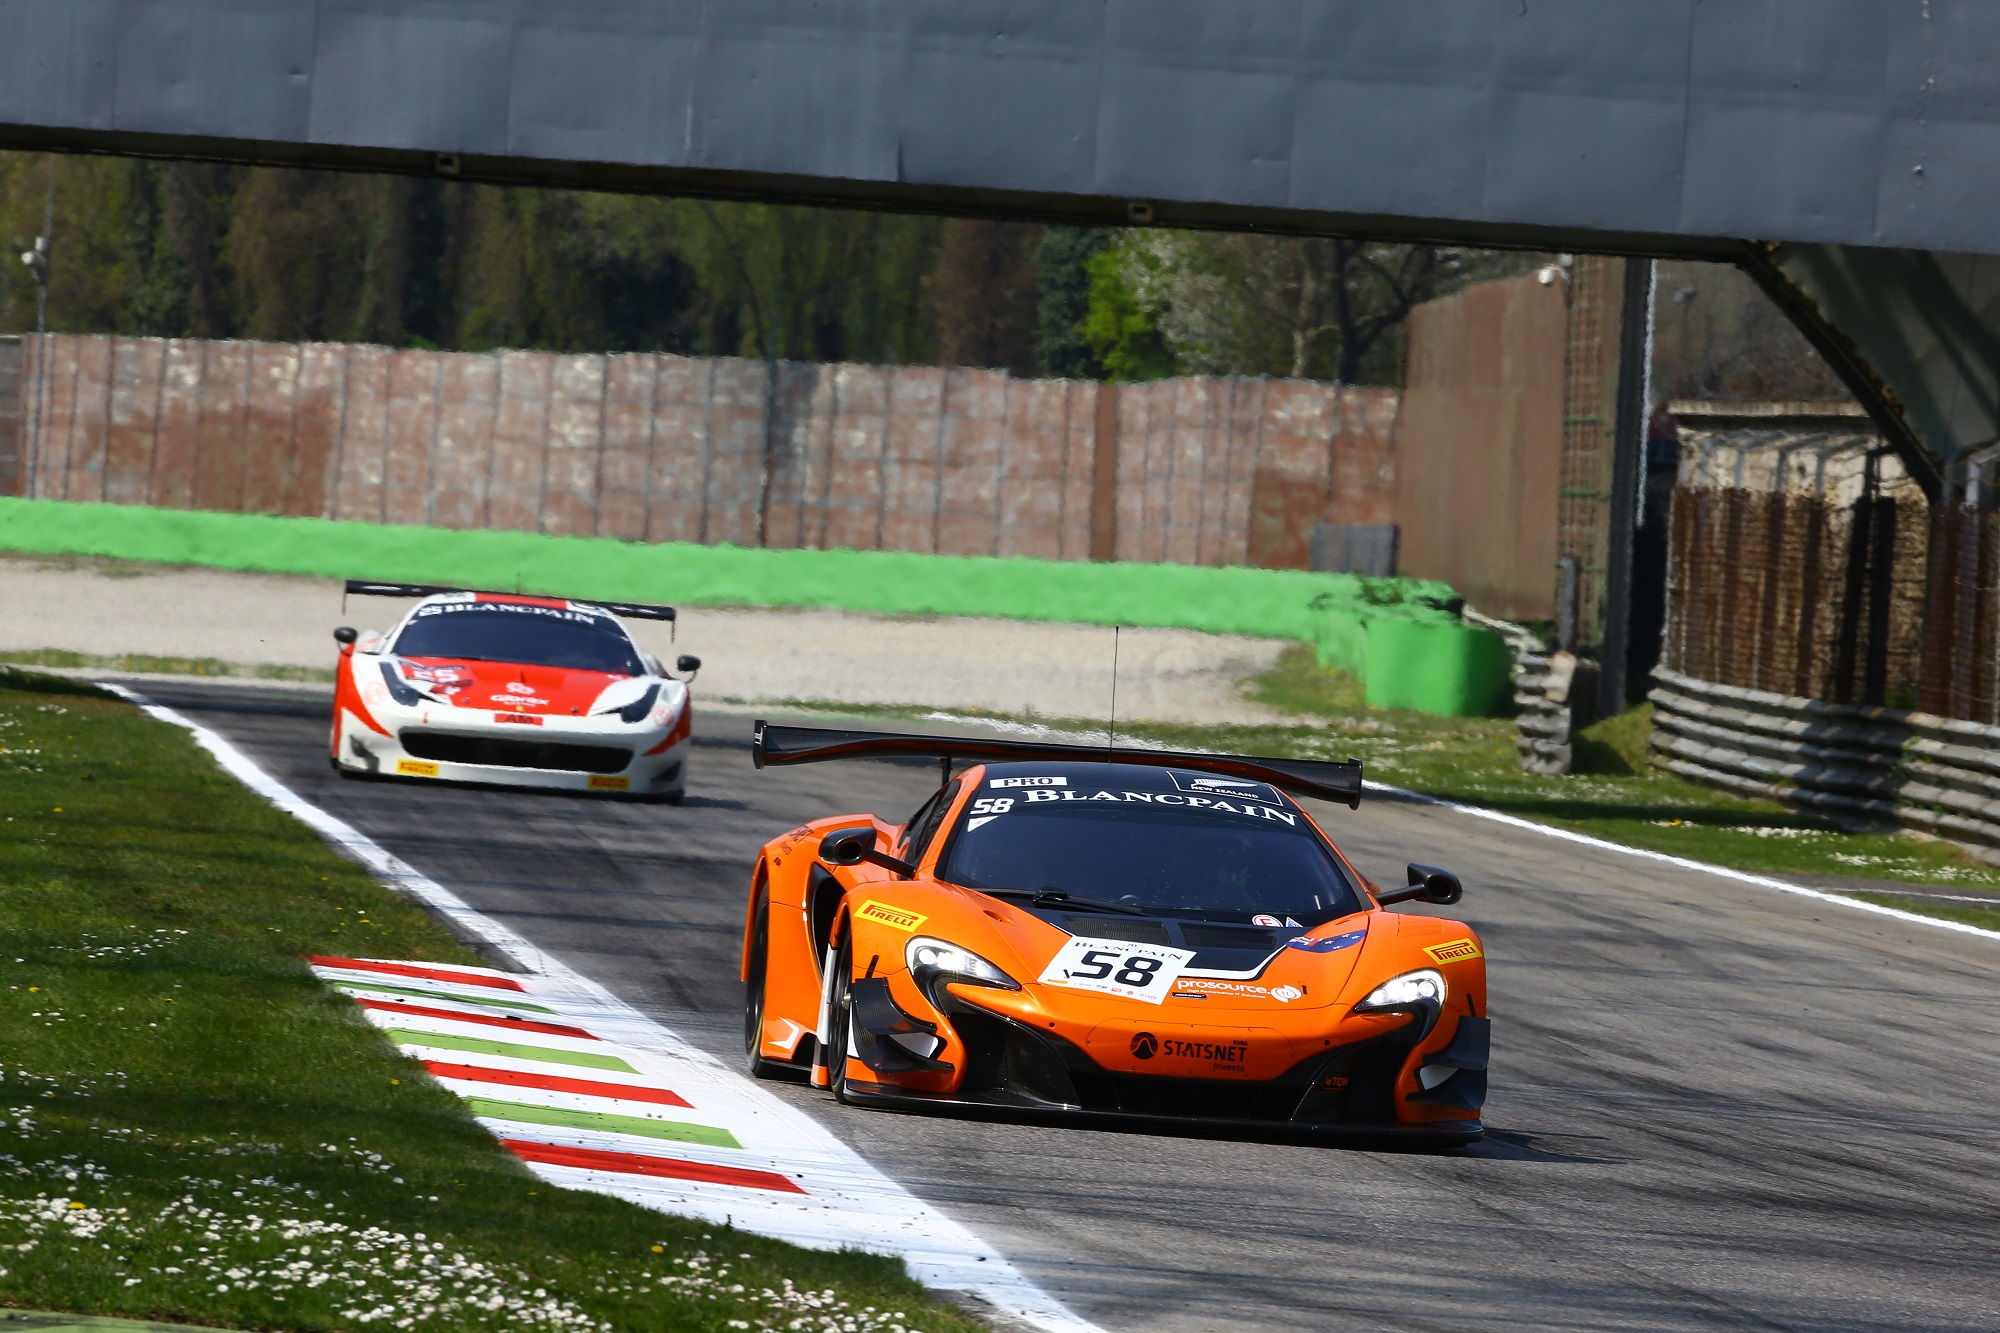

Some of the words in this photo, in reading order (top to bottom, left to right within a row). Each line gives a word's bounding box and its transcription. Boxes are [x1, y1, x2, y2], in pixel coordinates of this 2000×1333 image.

[445, 602, 596, 625] BLANCPAIN
[1003, 777, 1053, 787] PRO
[1215, 788, 1259, 799] ZEALAND
[969, 797, 1015, 815] 58
[1022, 789, 1298, 826] BLANCPAIN
[862, 904, 920, 927] PIRELLI
[1074, 942, 1183, 960] BLANCPAIN
[1430, 942, 1476, 960] PIRELLI
[1070, 950, 1163, 987] 58
[1163, 1039, 1248, 1062] STATSNET
[1213, 1062, 1245, 1072] Invests
[1332, 1077, 1350, 1086] TOW
